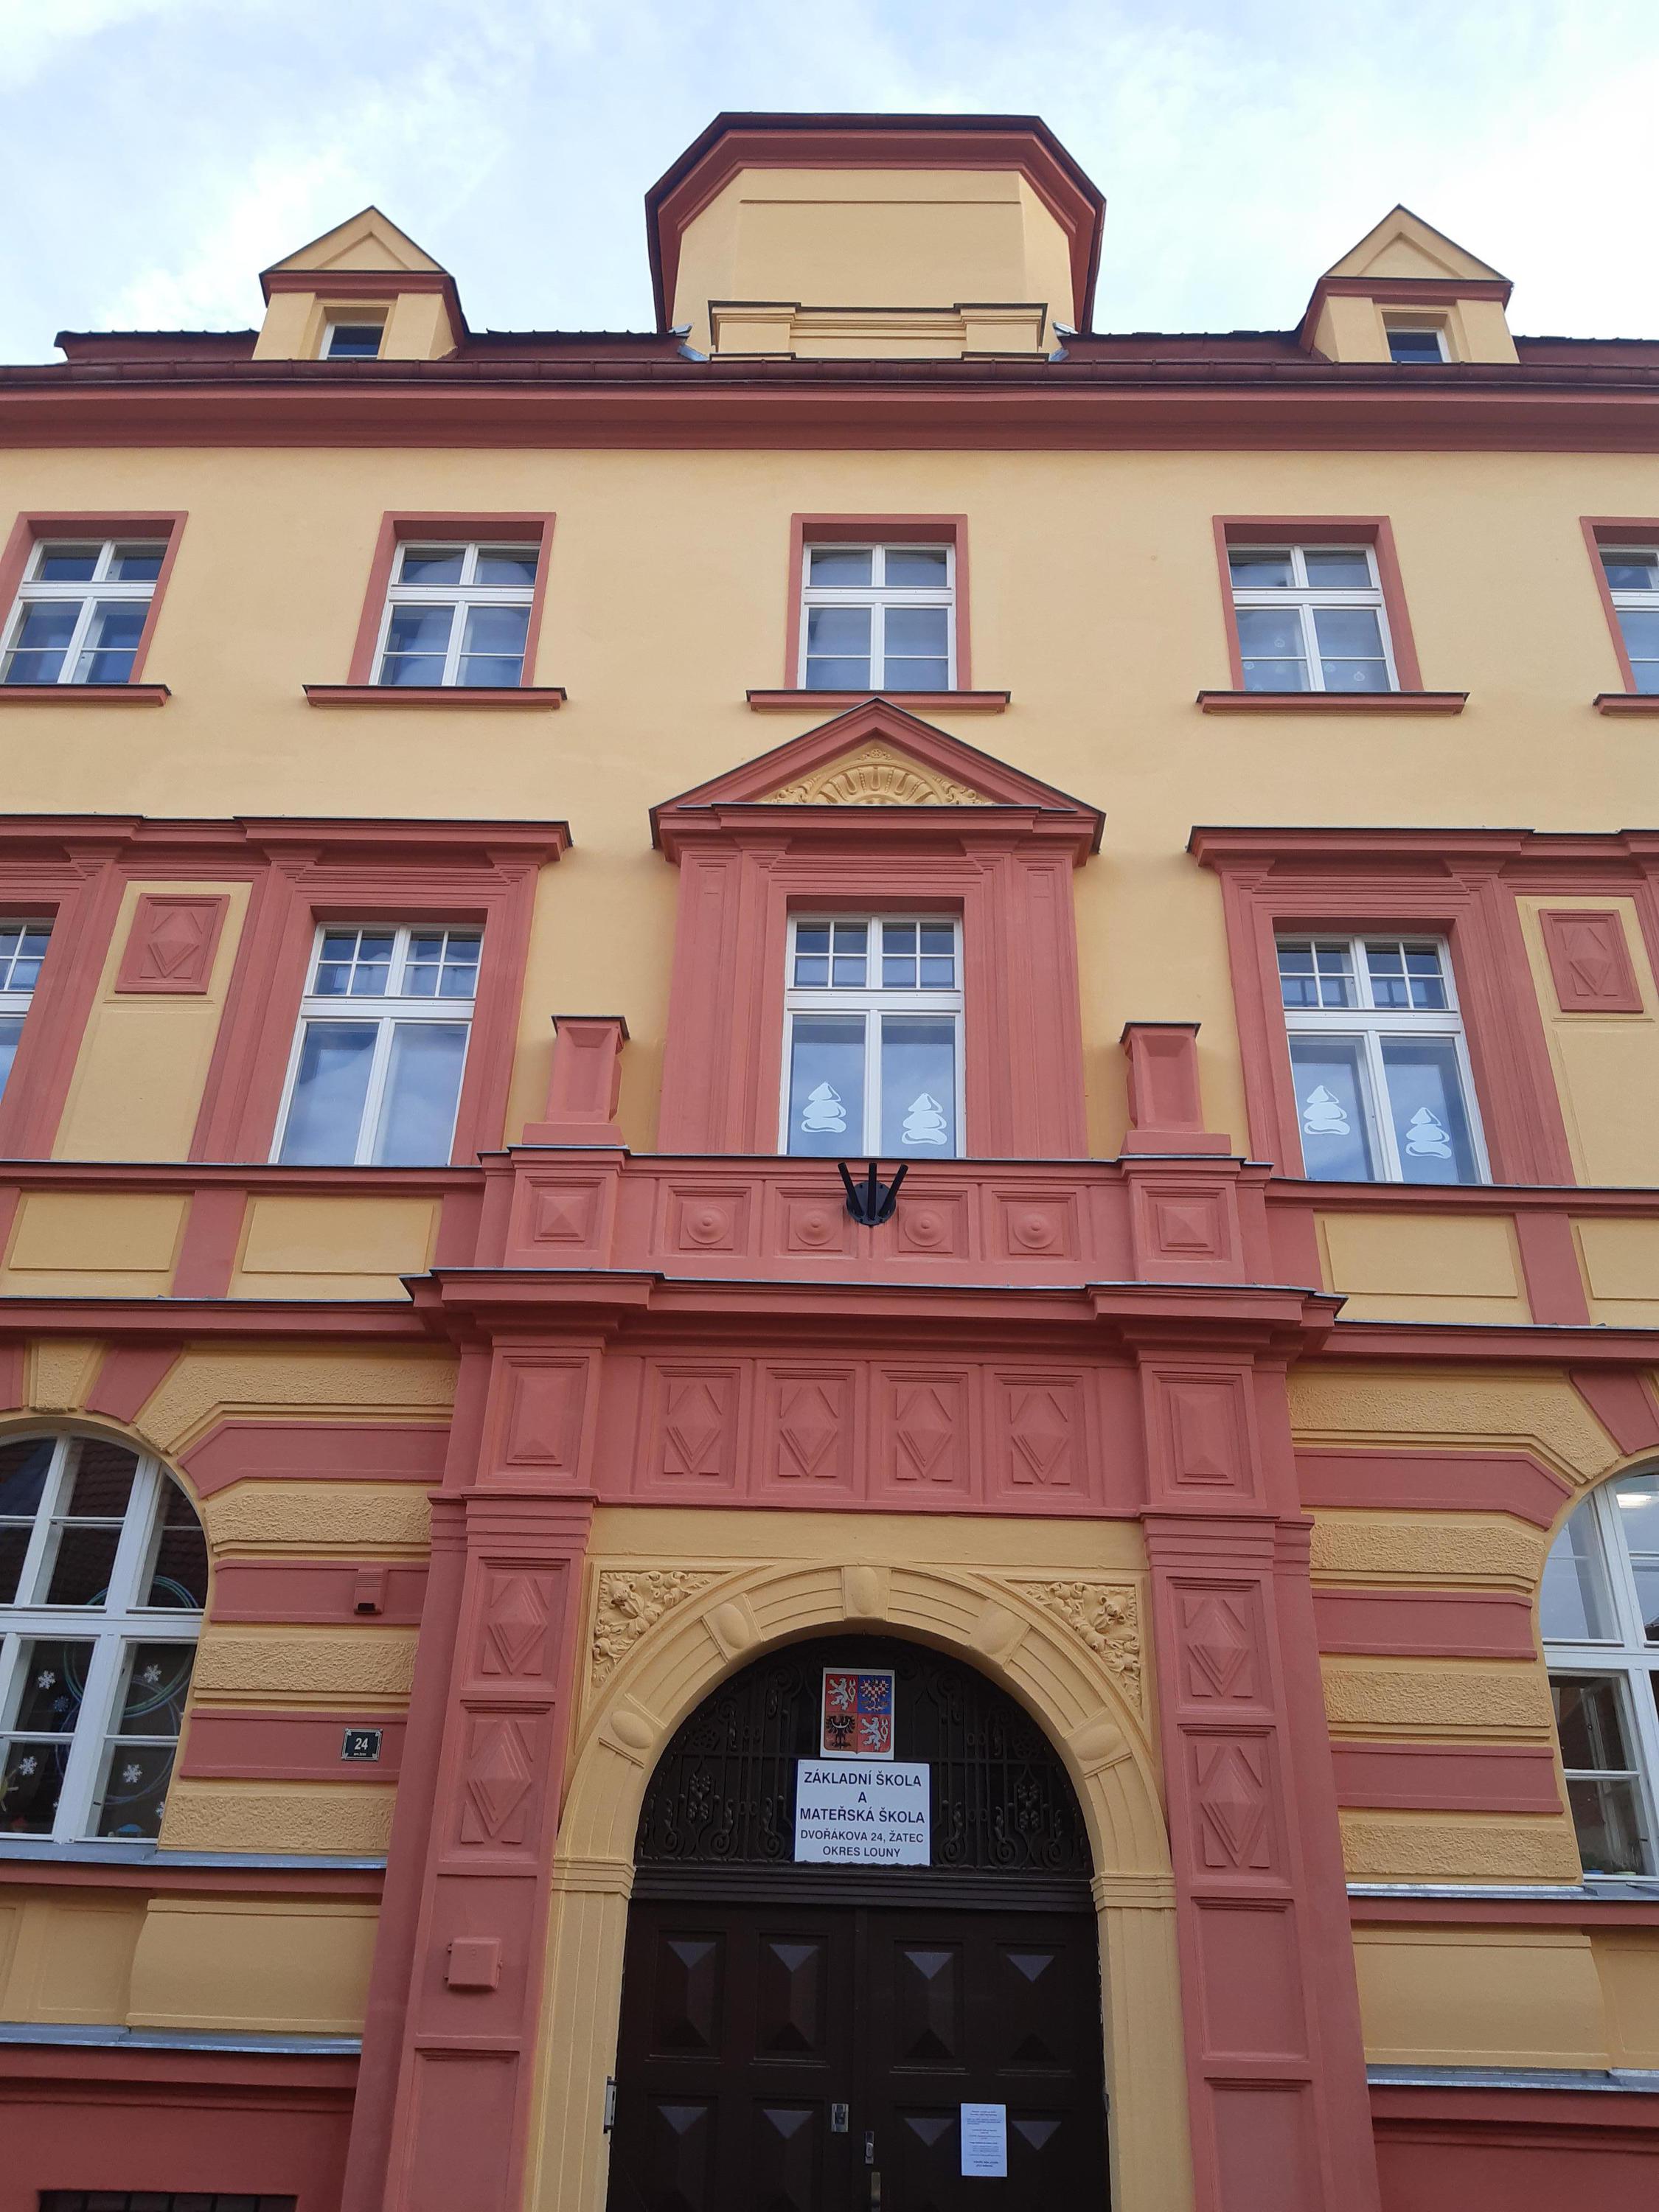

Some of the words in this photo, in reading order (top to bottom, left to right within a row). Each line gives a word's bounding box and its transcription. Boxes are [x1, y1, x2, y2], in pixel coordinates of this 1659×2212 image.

[354, 1737, 369, 1750] 24
[804, 1769, 872, 1785] ZÁKLADNÍ
[876, 1770, 922, 1787] ŠKOLA
[858, 1792, 867, 1804] A
[800, 1805, 874, 1822] MATEŘSKÁ
[879, 1806, 925, 1823] ŠKOLA
[801, 1828, 868, 1842] DVOŘÁKOVA
[871, 1832, 886, 1843] 24,
[888, 1830, 924, 1843] ŽATEC
[822, 1846, 860, 1857] OKRES
[863, 1847, 901, 1857] LOUNY
